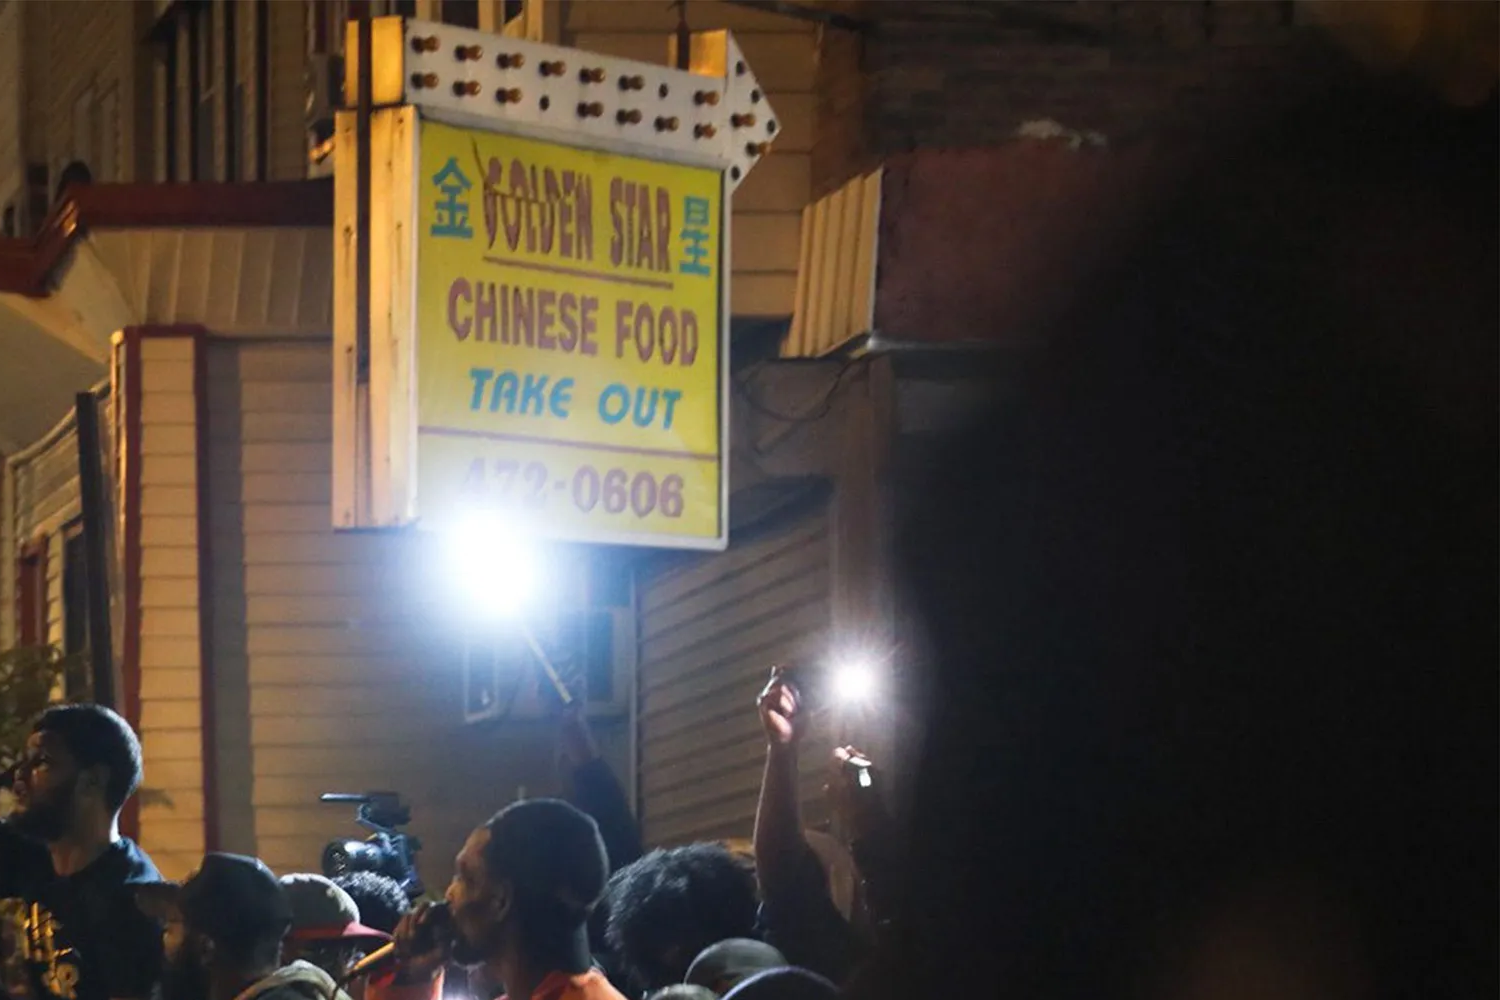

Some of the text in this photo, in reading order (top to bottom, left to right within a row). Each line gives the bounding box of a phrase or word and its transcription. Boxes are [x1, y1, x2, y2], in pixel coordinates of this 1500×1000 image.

[430, 155, 474, 240] 金
[483, 156, 671, 273] GOLDEN STAR
[679, 195, 711, 277] 星
[448, 277, 699, 367] CHINESE FOOD
[469, 367, 682, 430] TAKE OUT
[463, 456, 685, 519] 472-0606
